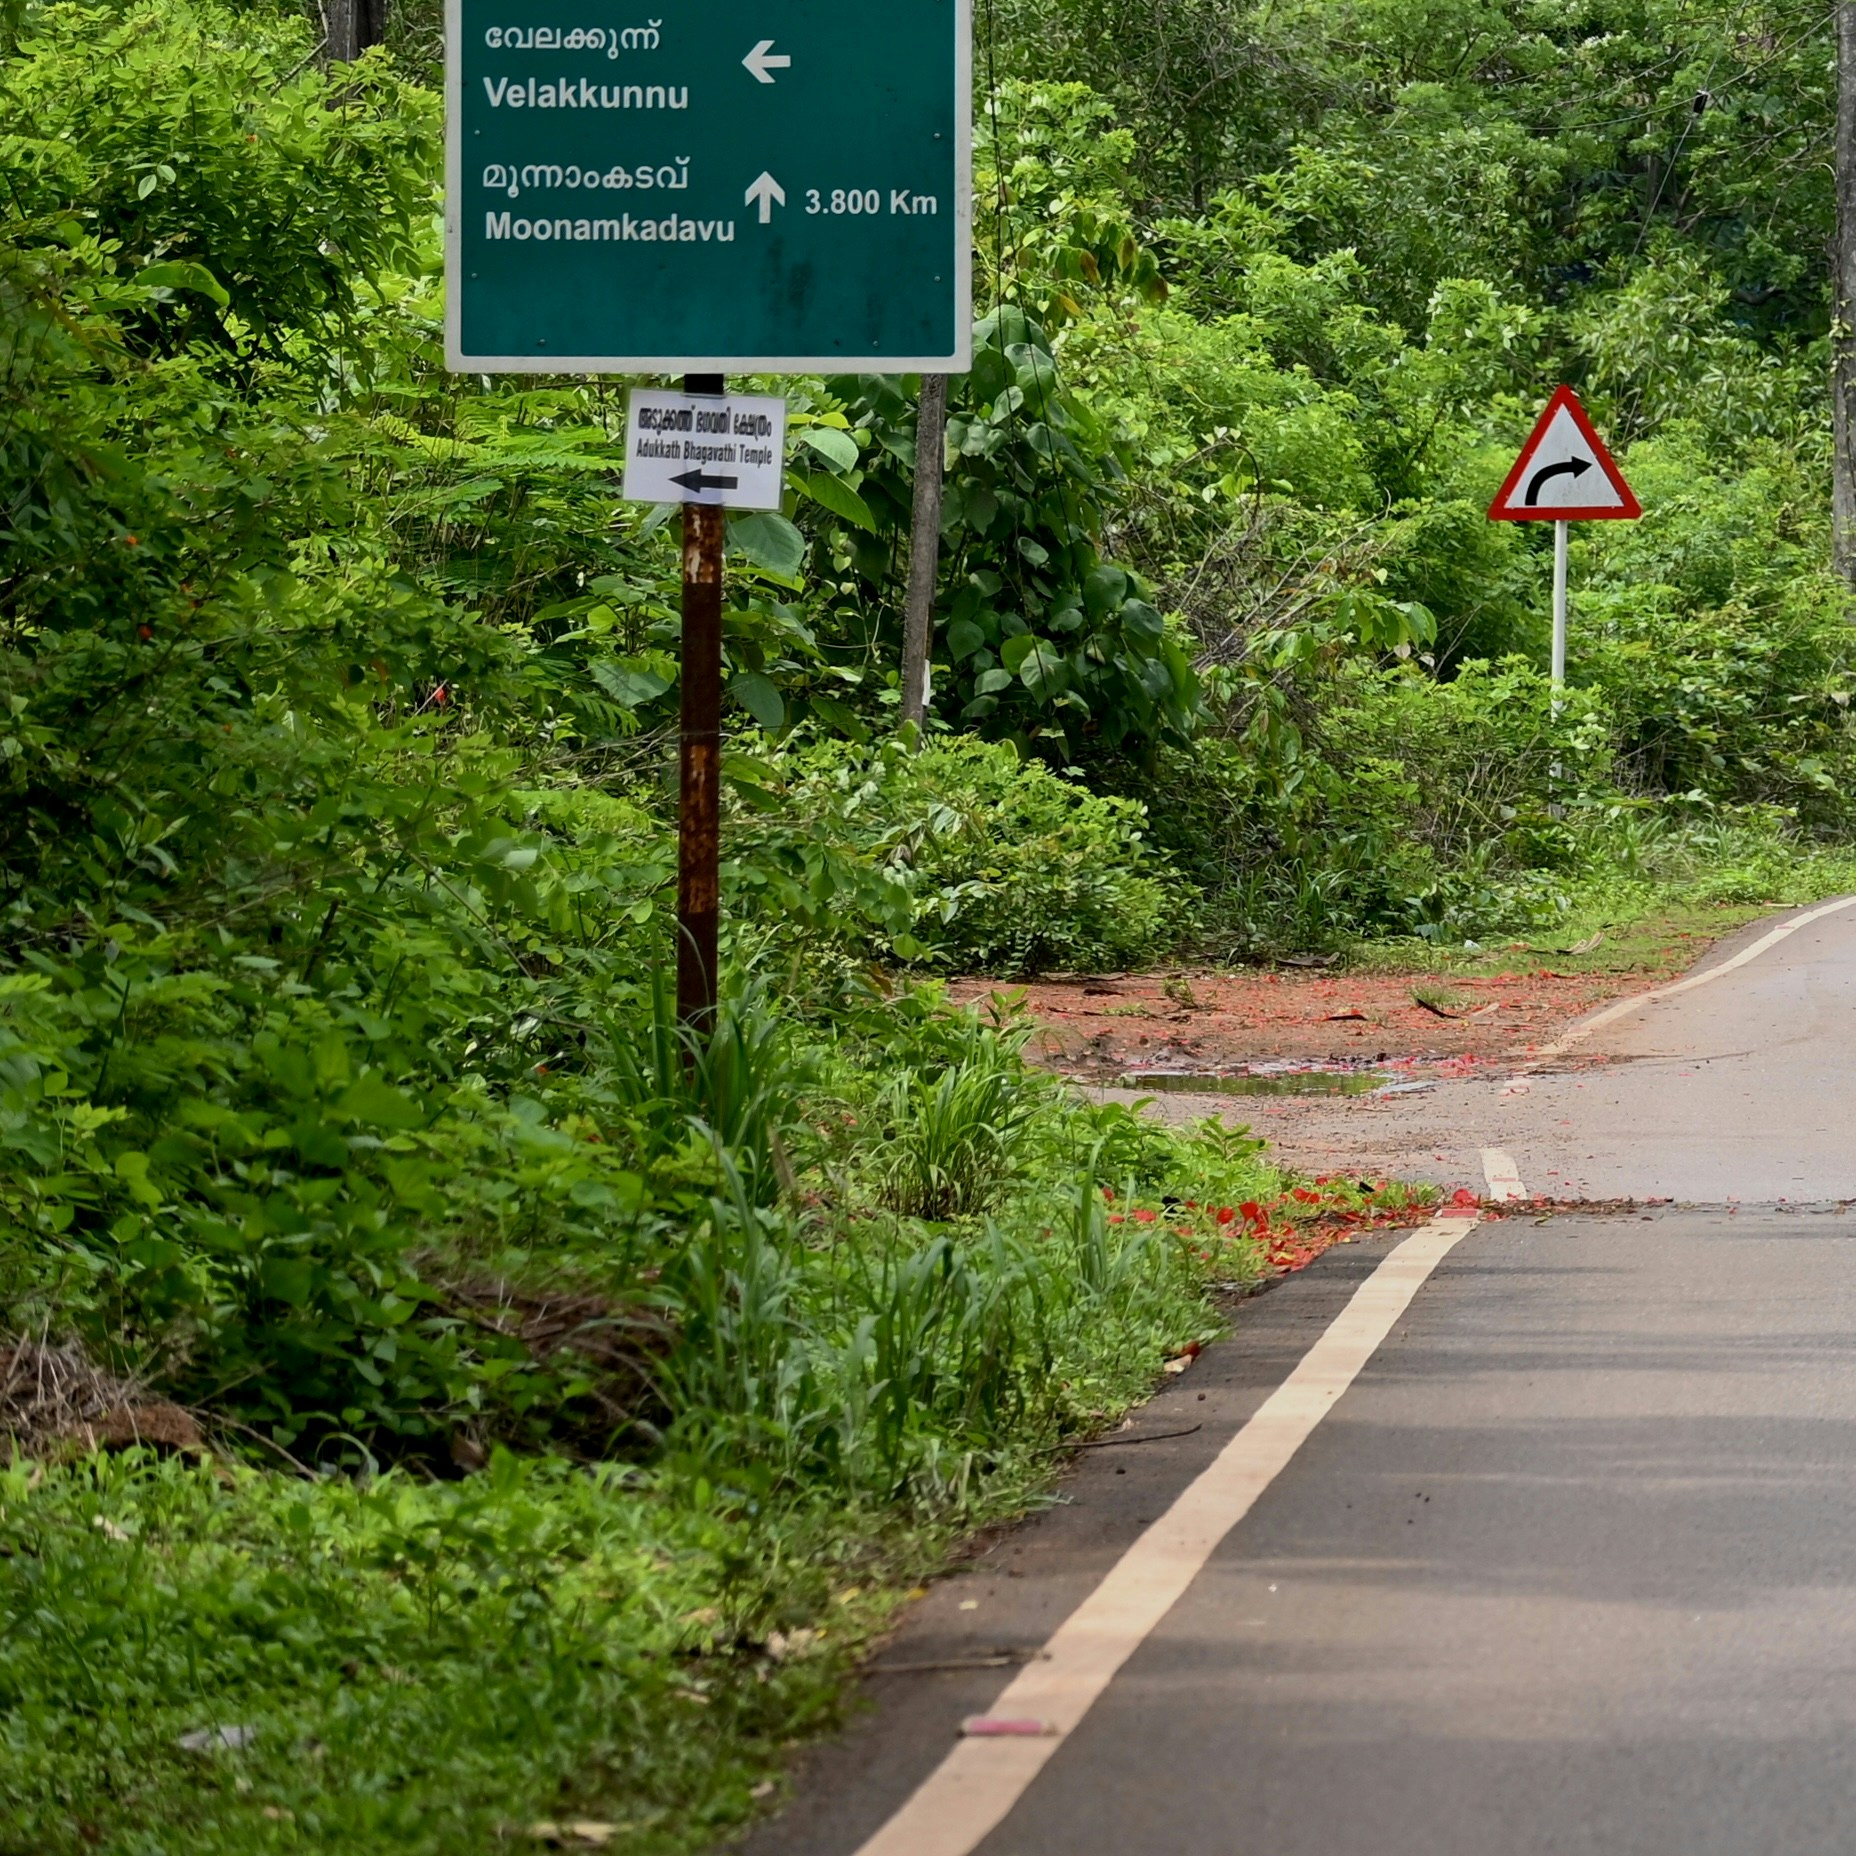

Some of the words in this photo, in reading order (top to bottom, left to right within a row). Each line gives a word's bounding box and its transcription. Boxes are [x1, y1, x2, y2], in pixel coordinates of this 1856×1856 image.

[484, 19, 663, 60] വേലക്കുന്ന്
[483, 76, 689, 109] Velakkunnu
[805, 188, 880, 215] 3.800
[889, 189, 938, 215] Km
[485, 211, 735, 242] Moonamkadavu
[636, 437, 681, 460] Adukkath
[683, 440, 737, 466] Bhagavathi
[739, 443, 773, 469] Temple
